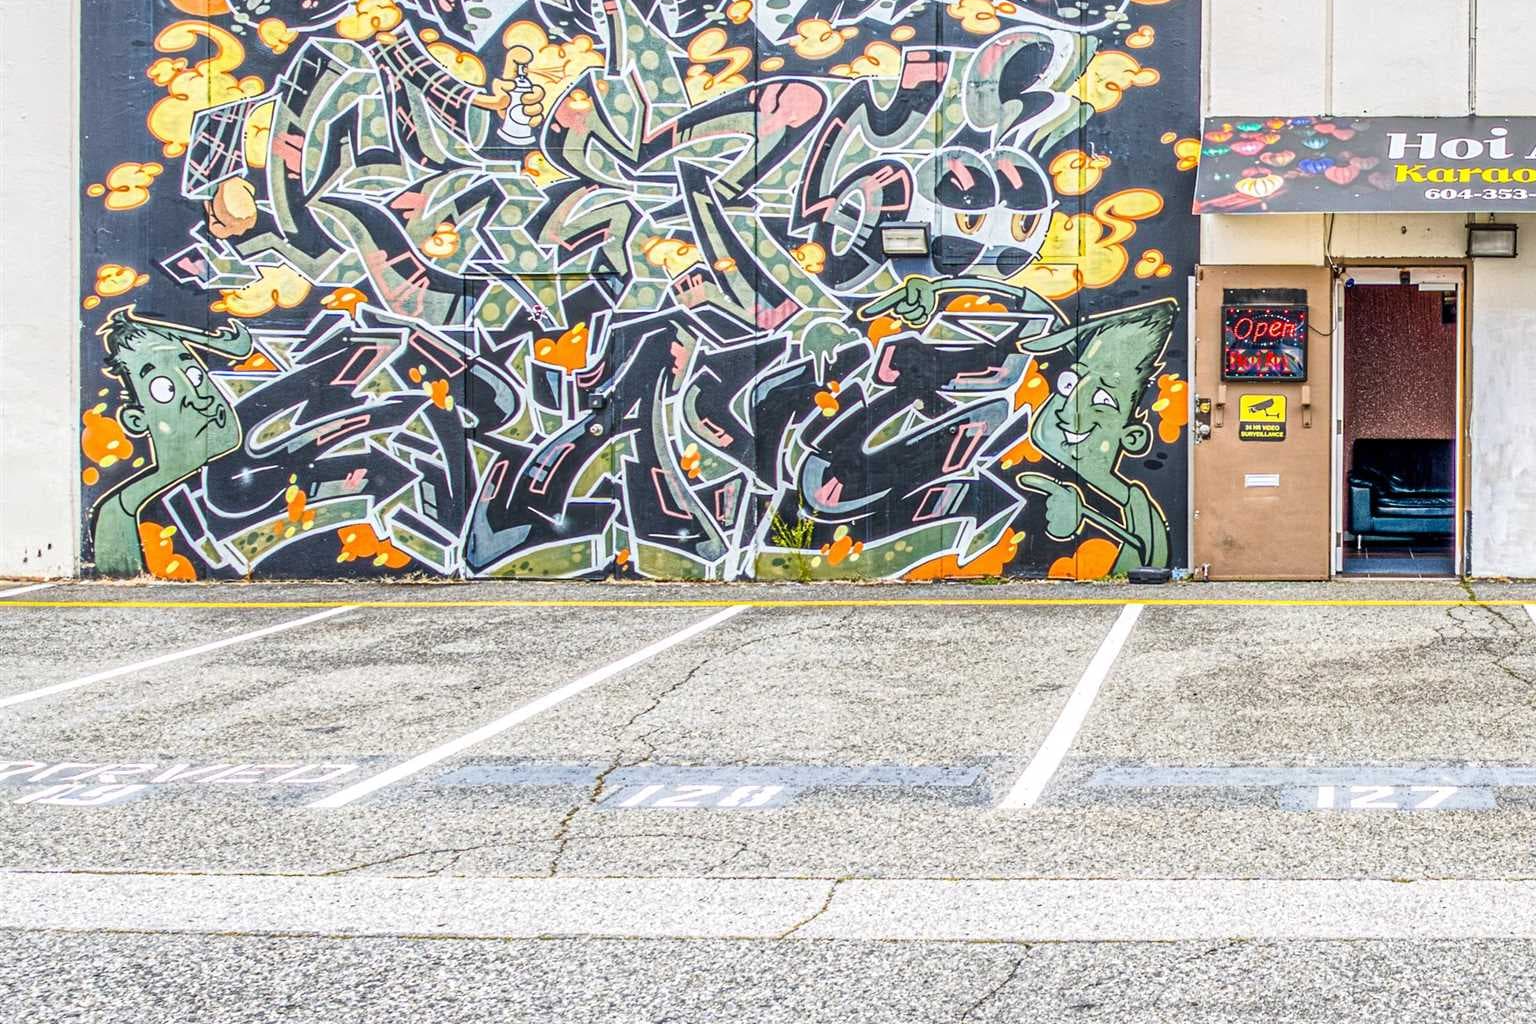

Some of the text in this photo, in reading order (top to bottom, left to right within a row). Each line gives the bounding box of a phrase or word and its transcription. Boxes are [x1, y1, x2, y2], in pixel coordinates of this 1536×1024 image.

[1386, 127, 1514, 160] Hoi
[1234, 317, 1297, 343] Open
[617, 784, 786, 807] 128
[1316, 786, 1458, 809] 127
